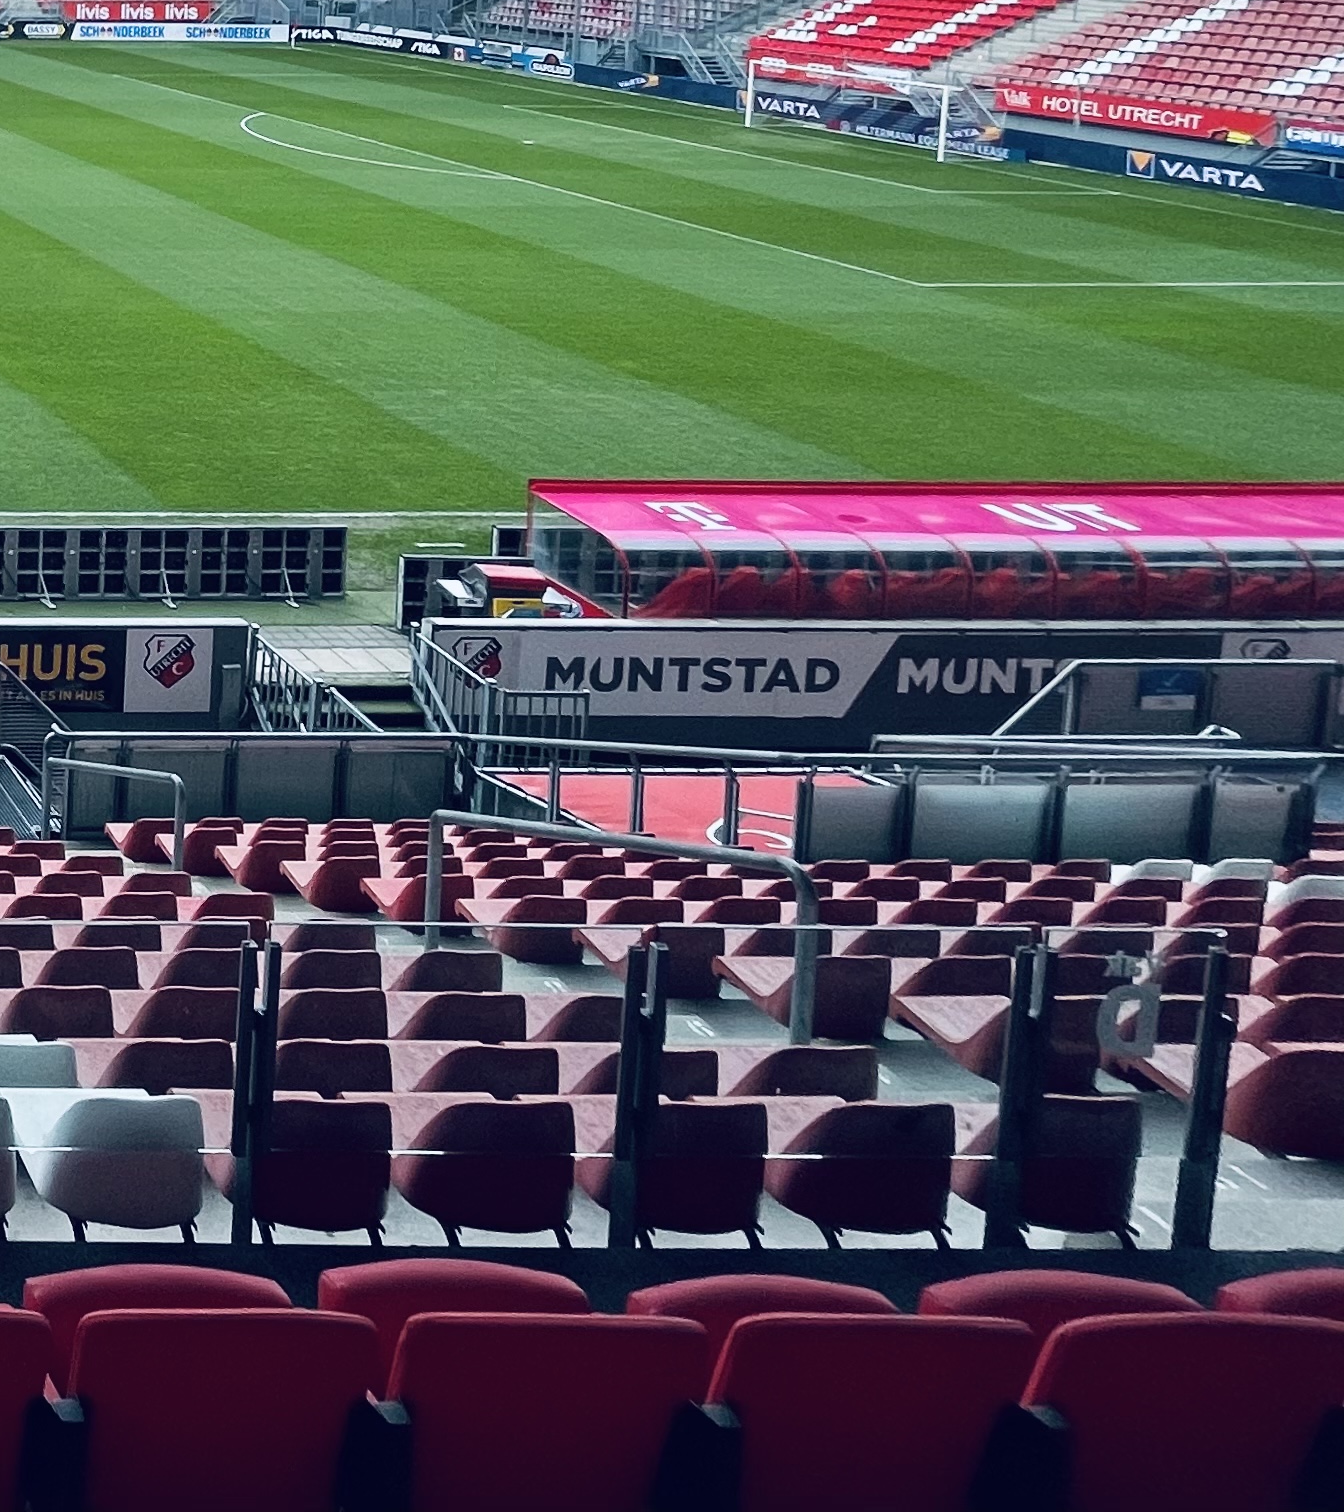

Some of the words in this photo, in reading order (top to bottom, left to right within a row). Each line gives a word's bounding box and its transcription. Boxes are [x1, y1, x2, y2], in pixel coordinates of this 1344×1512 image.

[77, 3, 109, 20] livis
[121, 3, 154, 20] livis
[165, 4, 198, 20] livis
[411, 41, 440, 55] STIGA
[757, 96, 821, 119] VARTA
[1042, 95, 1103, 119] HOTEL
[1108, 104, 1204, 130] UTRECHT
[1159, 158, 1265, 192] VARTA
[157, 640, 165, 653] F
[464, 642, 472, 655] F
[172, 662, 184, 676] C
[544, 656, 841, 694] MUNTSTAD
[59, 690, 72, 701] IN
[75, 690, 105, 701] HUIS
